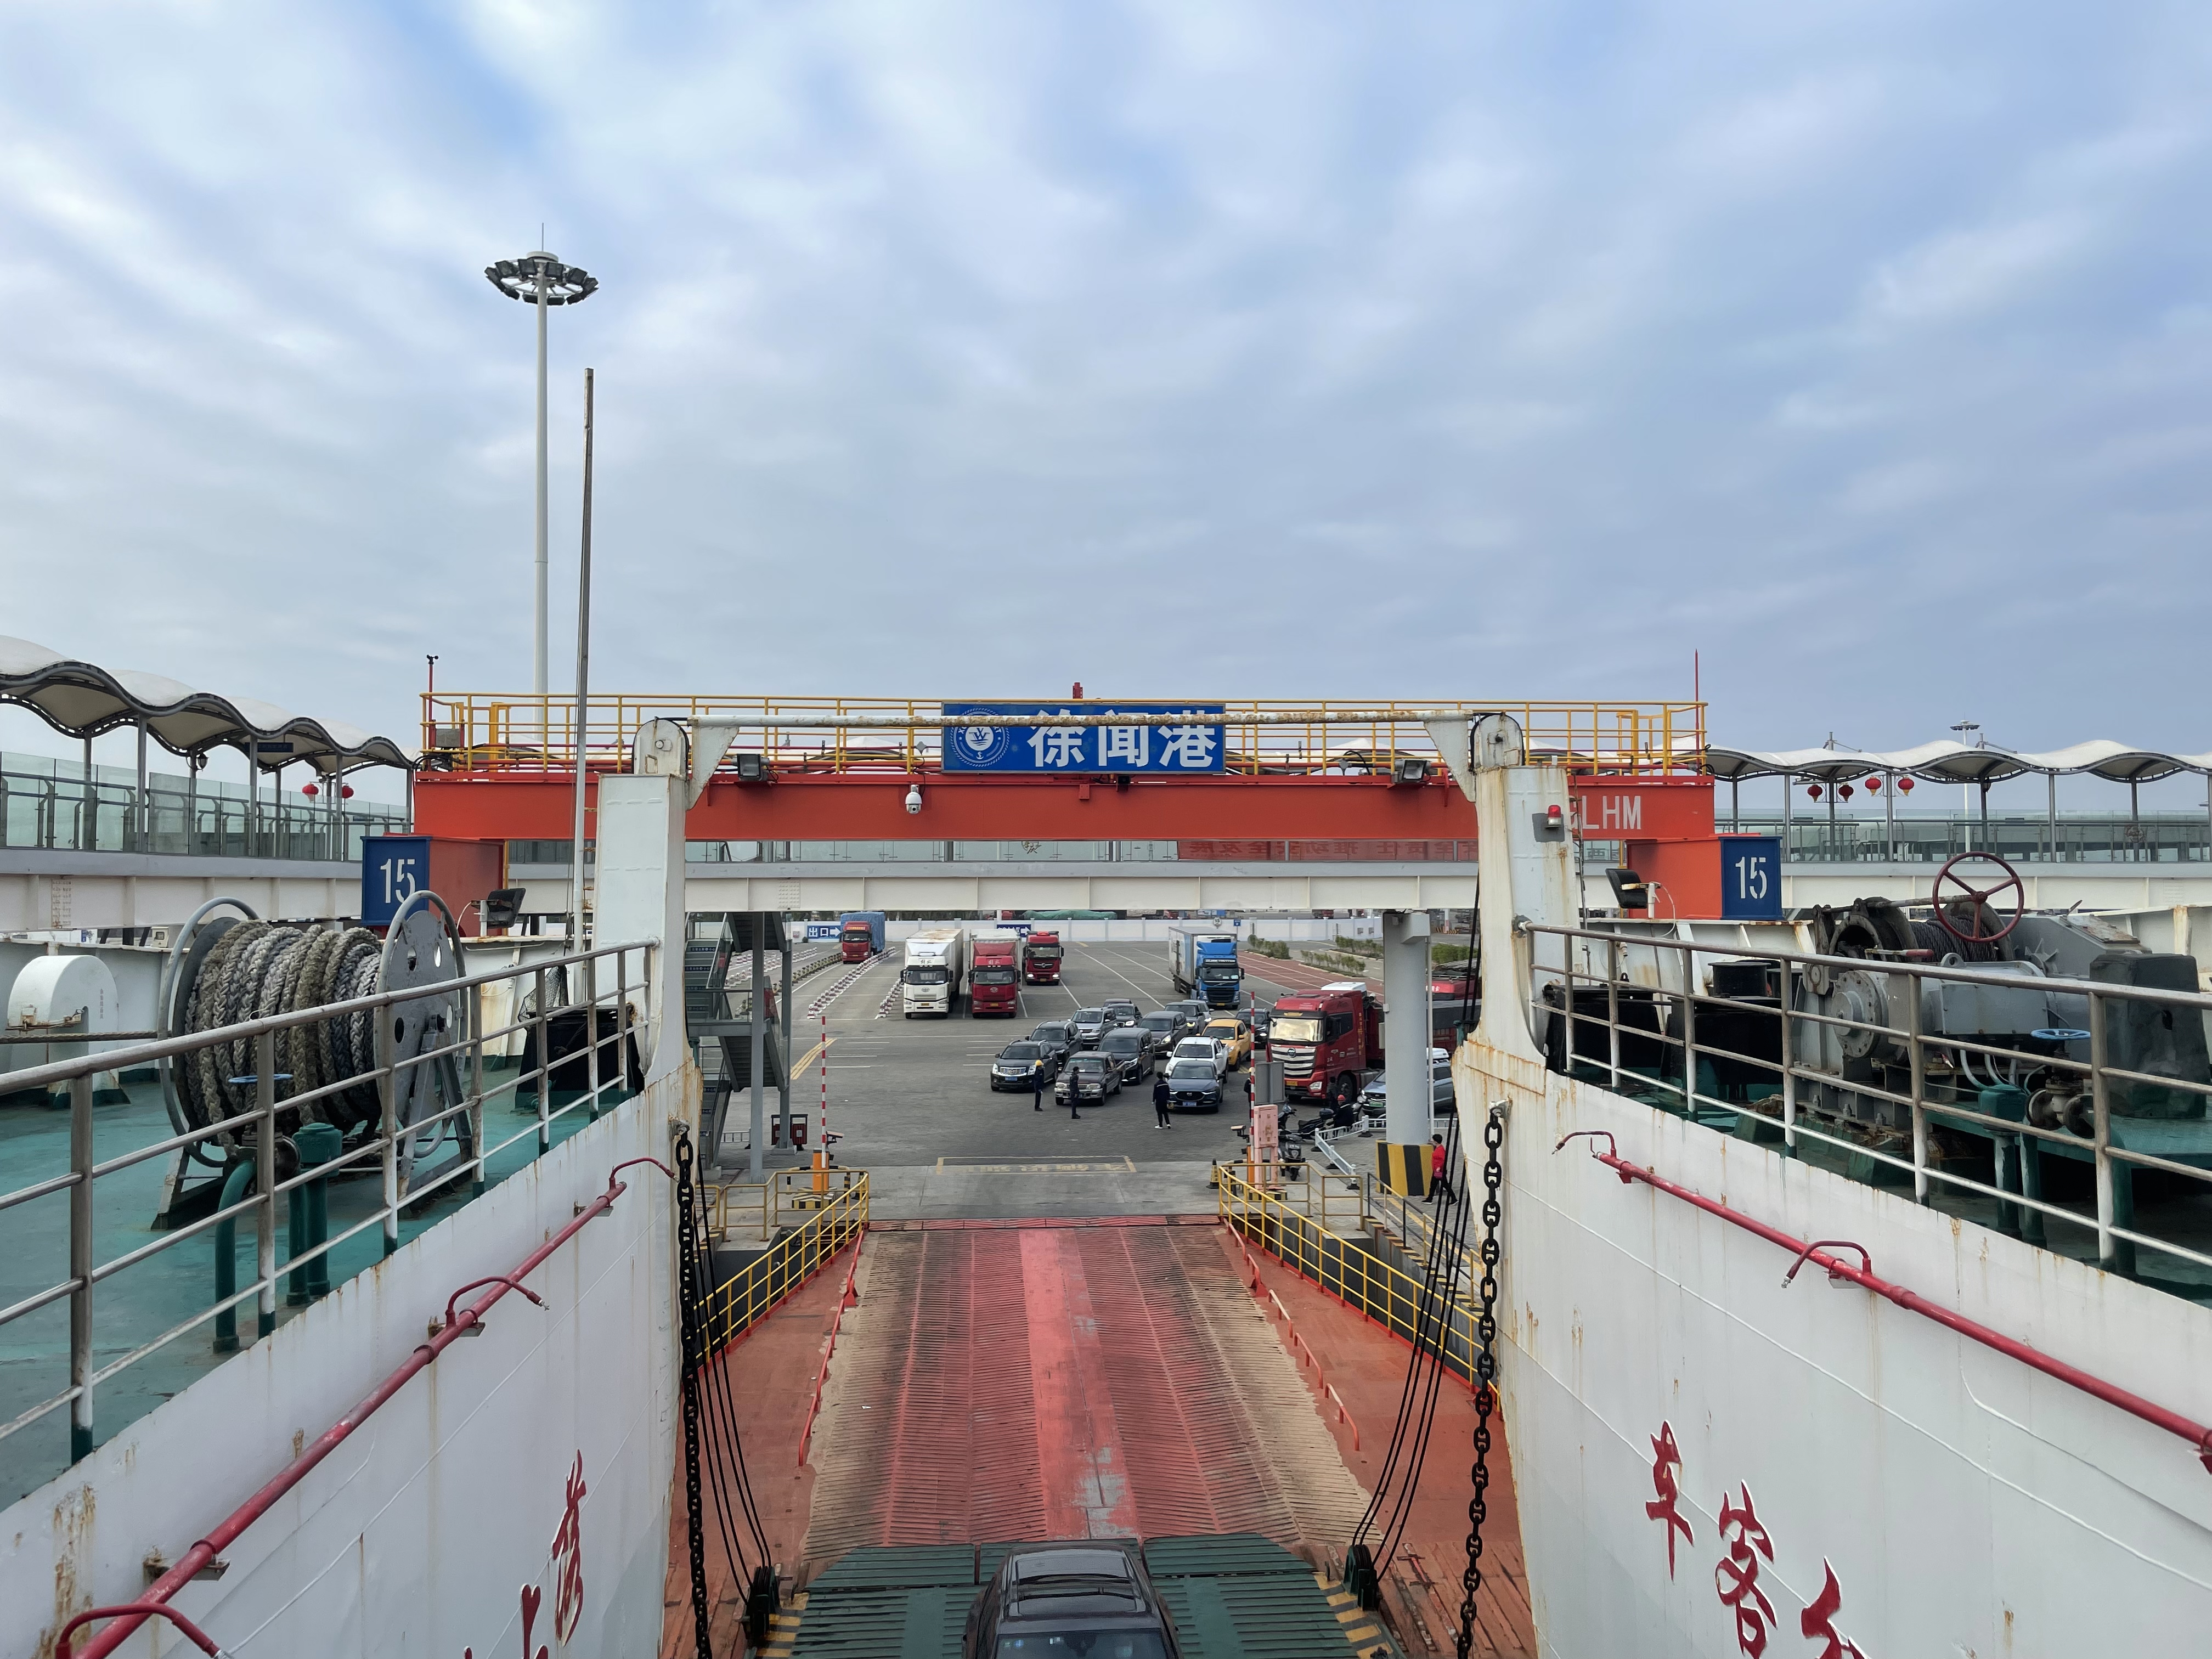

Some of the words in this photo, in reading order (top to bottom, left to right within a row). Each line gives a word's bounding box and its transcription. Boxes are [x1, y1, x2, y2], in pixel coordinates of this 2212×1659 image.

[1028, 708, 1217, 767] 徐闻港
[380, 858, 416, 904] 15
[1735, 856, 1768, 899] 15
[808, 927, 830, 938] 出口
